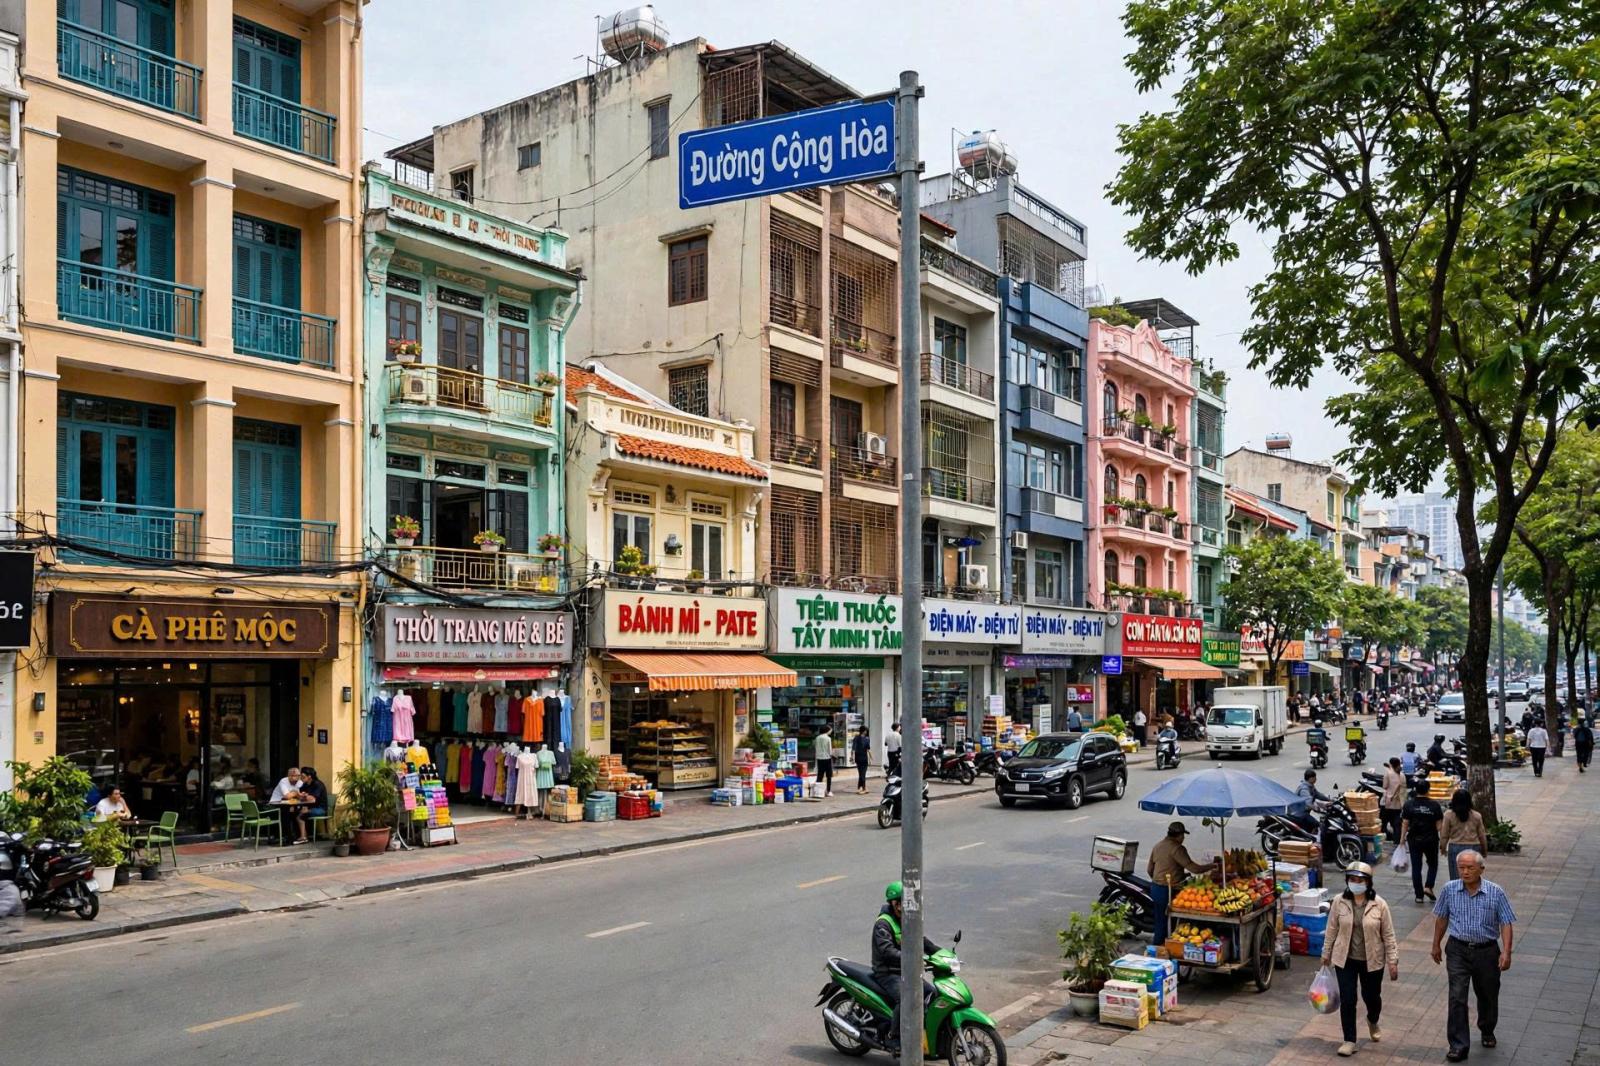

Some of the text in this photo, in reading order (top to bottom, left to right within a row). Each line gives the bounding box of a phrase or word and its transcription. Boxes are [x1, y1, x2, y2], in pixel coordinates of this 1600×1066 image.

[690, 119, 887, 186] Đường Cộng Hòa
[619, 597, 674, 634] BÁNH
[678, 600, 700, 634] MÌ
[716, 609, 758, 636] PATE
[796, 593, 897, 626] TIỆM THUỐC
[929, 608, 954, 637] ĐIỆN
[956, 610, 977, 634] MÁY
[1026, 611, 1047, 638] ĐIỆN
[1049, 613, 1067, 636] MÁY
[112, 607, 297, 647] CÀ PHÊ MỘC
[395, 609, 439, 643] THỜI
[443, 619, 501, 644] TRANG
[530, 620, 542, 645] &
[545, 615, 566, 645] BÉ
[792, 621, 903, 649] TÂY MINH TÂM
